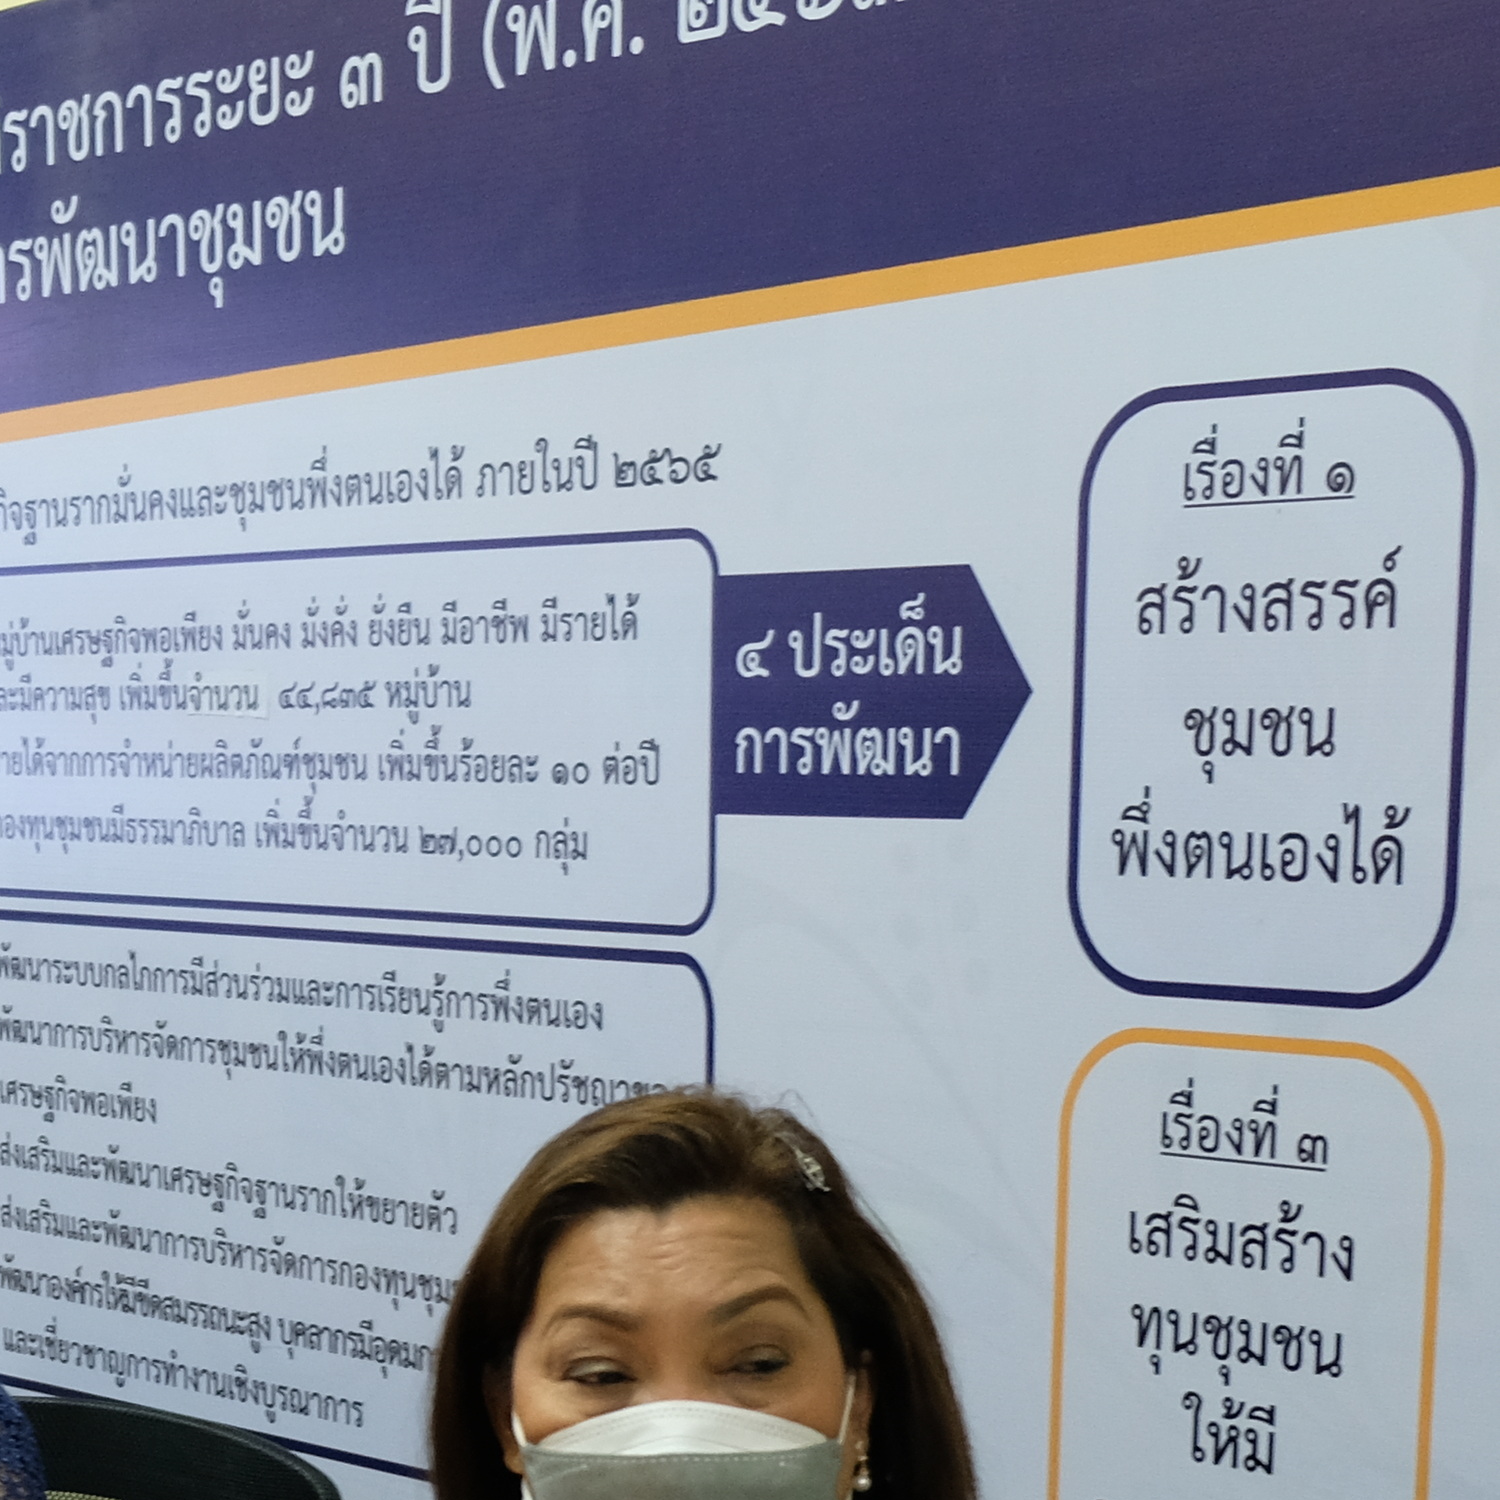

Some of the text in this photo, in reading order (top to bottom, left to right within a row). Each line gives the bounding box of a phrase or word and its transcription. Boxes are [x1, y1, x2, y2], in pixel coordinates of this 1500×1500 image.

[339, 53, 384, 110] ๓
[406, 0, 452, 94] ปี
[475, 435, 599, 499] ภายในปี
[613, 442, 723, 489] ๒๕๖๕
[1182, 416, 1357, 502] เรื่องที่ ๑
[231, 600, 291, 652] มั่นคง
[300, 595, 358, 649] มั่งคั่ง
[368, 592, 431, 648] ยั่งยืน
[441, 597, 530, 645] มีอาชีพ
[540, 592, 640, 644] มีรายได้
[1135, 544, 1404, 635] สร้างสรรค์
[735, 591, 964, 678] ๔ ประเด็น
[119, 657, 260, 712] เพิ่มขึ้นจำนวน
[384, 663, 472, 725] หมู่บ้าน
[377, 724, 539, 784] เพิ่มขึ้นร้อยละ
[551, 758, 590, 786] ๑๐
[602, 738, 661, 786] ต่อปี
[734, 699, 961, 777] การพัฒนา
[1183, 705, 1336, 785] ชุมชน
[254, 796, 409, 853] เพิ่มขึ้นจำนวน
[535, 817, 589, 875] กลุ่ม
[1110, 785, 1412, 886] พึ่งตนเองได้
[1159, 1077, 1330, 1166] เรื่องที่ ๓
[1127, 1193, 1356, 1282] เสริมสร้าง
[2, 1316, 366, 1429] และเชี่ยวชาญการทำงานเชิงบูรณาการ
[278, 1318, 438, 1380] บุคลากรมีอุดมก
[1130, 1301, 1344, 1386] ทุนชุมชน
[1181, 1391, 1277, 1475] ให้มี
